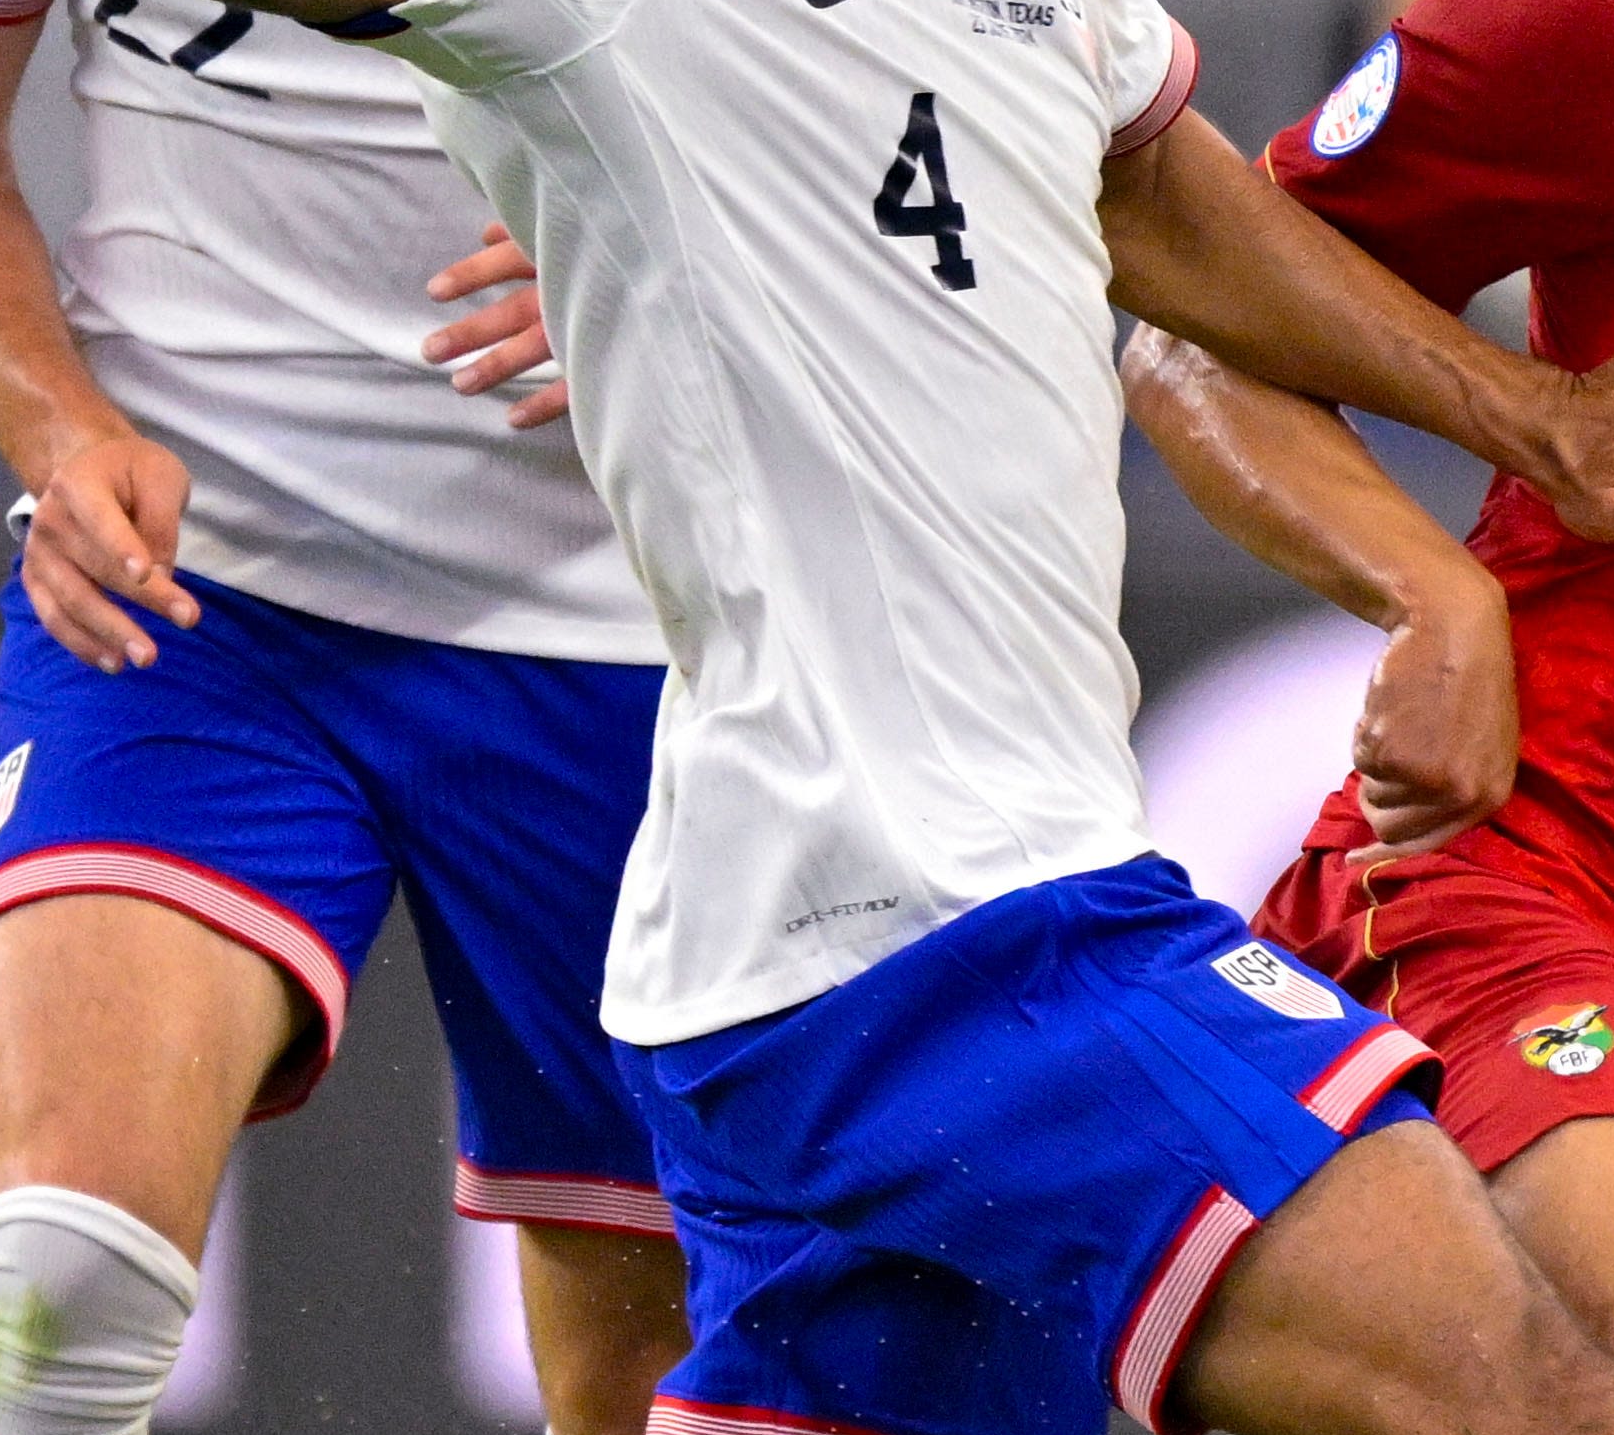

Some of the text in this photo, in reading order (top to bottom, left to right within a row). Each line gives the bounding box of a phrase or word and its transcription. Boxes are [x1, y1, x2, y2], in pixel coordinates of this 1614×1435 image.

[1006, 1, 1056, 27] TEXAS
[874, 92, 977, 291] 4
[1220, 948, 1280, 986] USA
